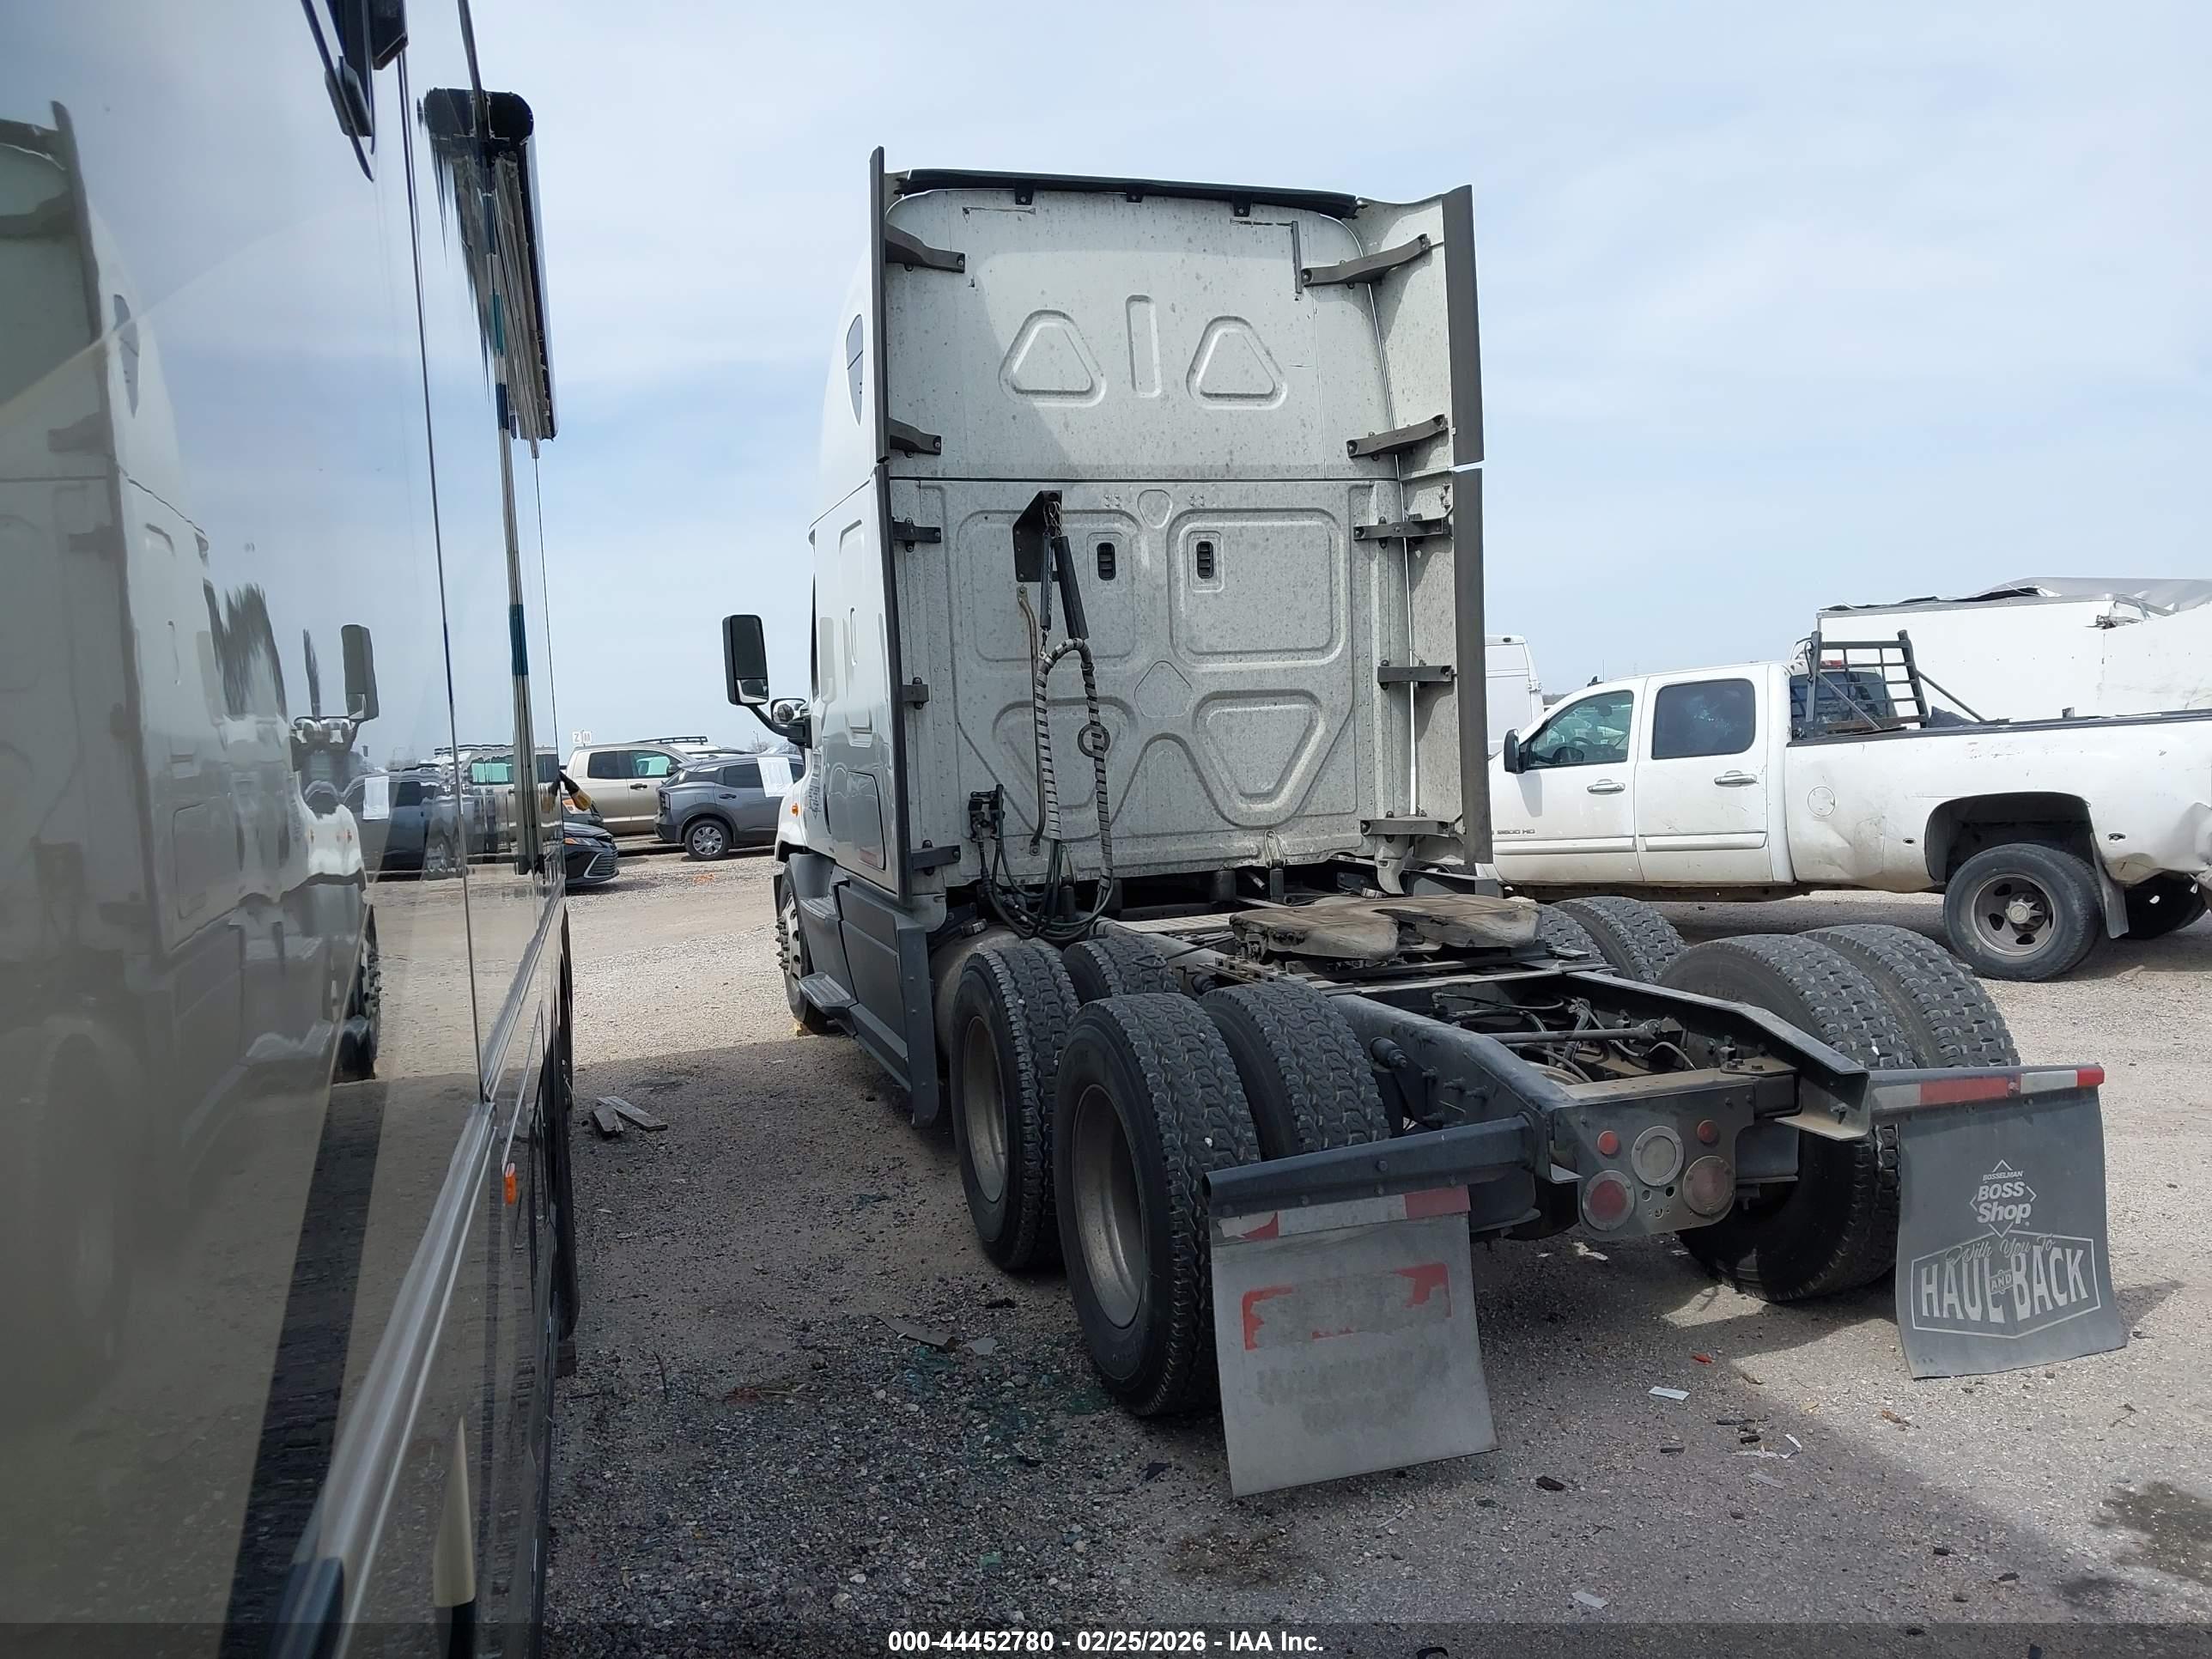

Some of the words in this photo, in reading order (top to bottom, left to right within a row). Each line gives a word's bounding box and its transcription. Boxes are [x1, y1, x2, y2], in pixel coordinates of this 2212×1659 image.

[1982, 1170, 2023, 1182] BOSSELMAN
[1977, 1181, 2026, 1201] BOSS
[1977, 1201, 2032, 1224] Shop
[1945, 1241, 1992, 1266] With
[1999, 1237, 2031, 1258] You
[2036, 1233, 2056, 1253] To
[1921, 1257, 2005, 1323] HAUL
[1990, 1276, 2012, 1291] AND
[2011, 1244, 2088, 1322] BACK
